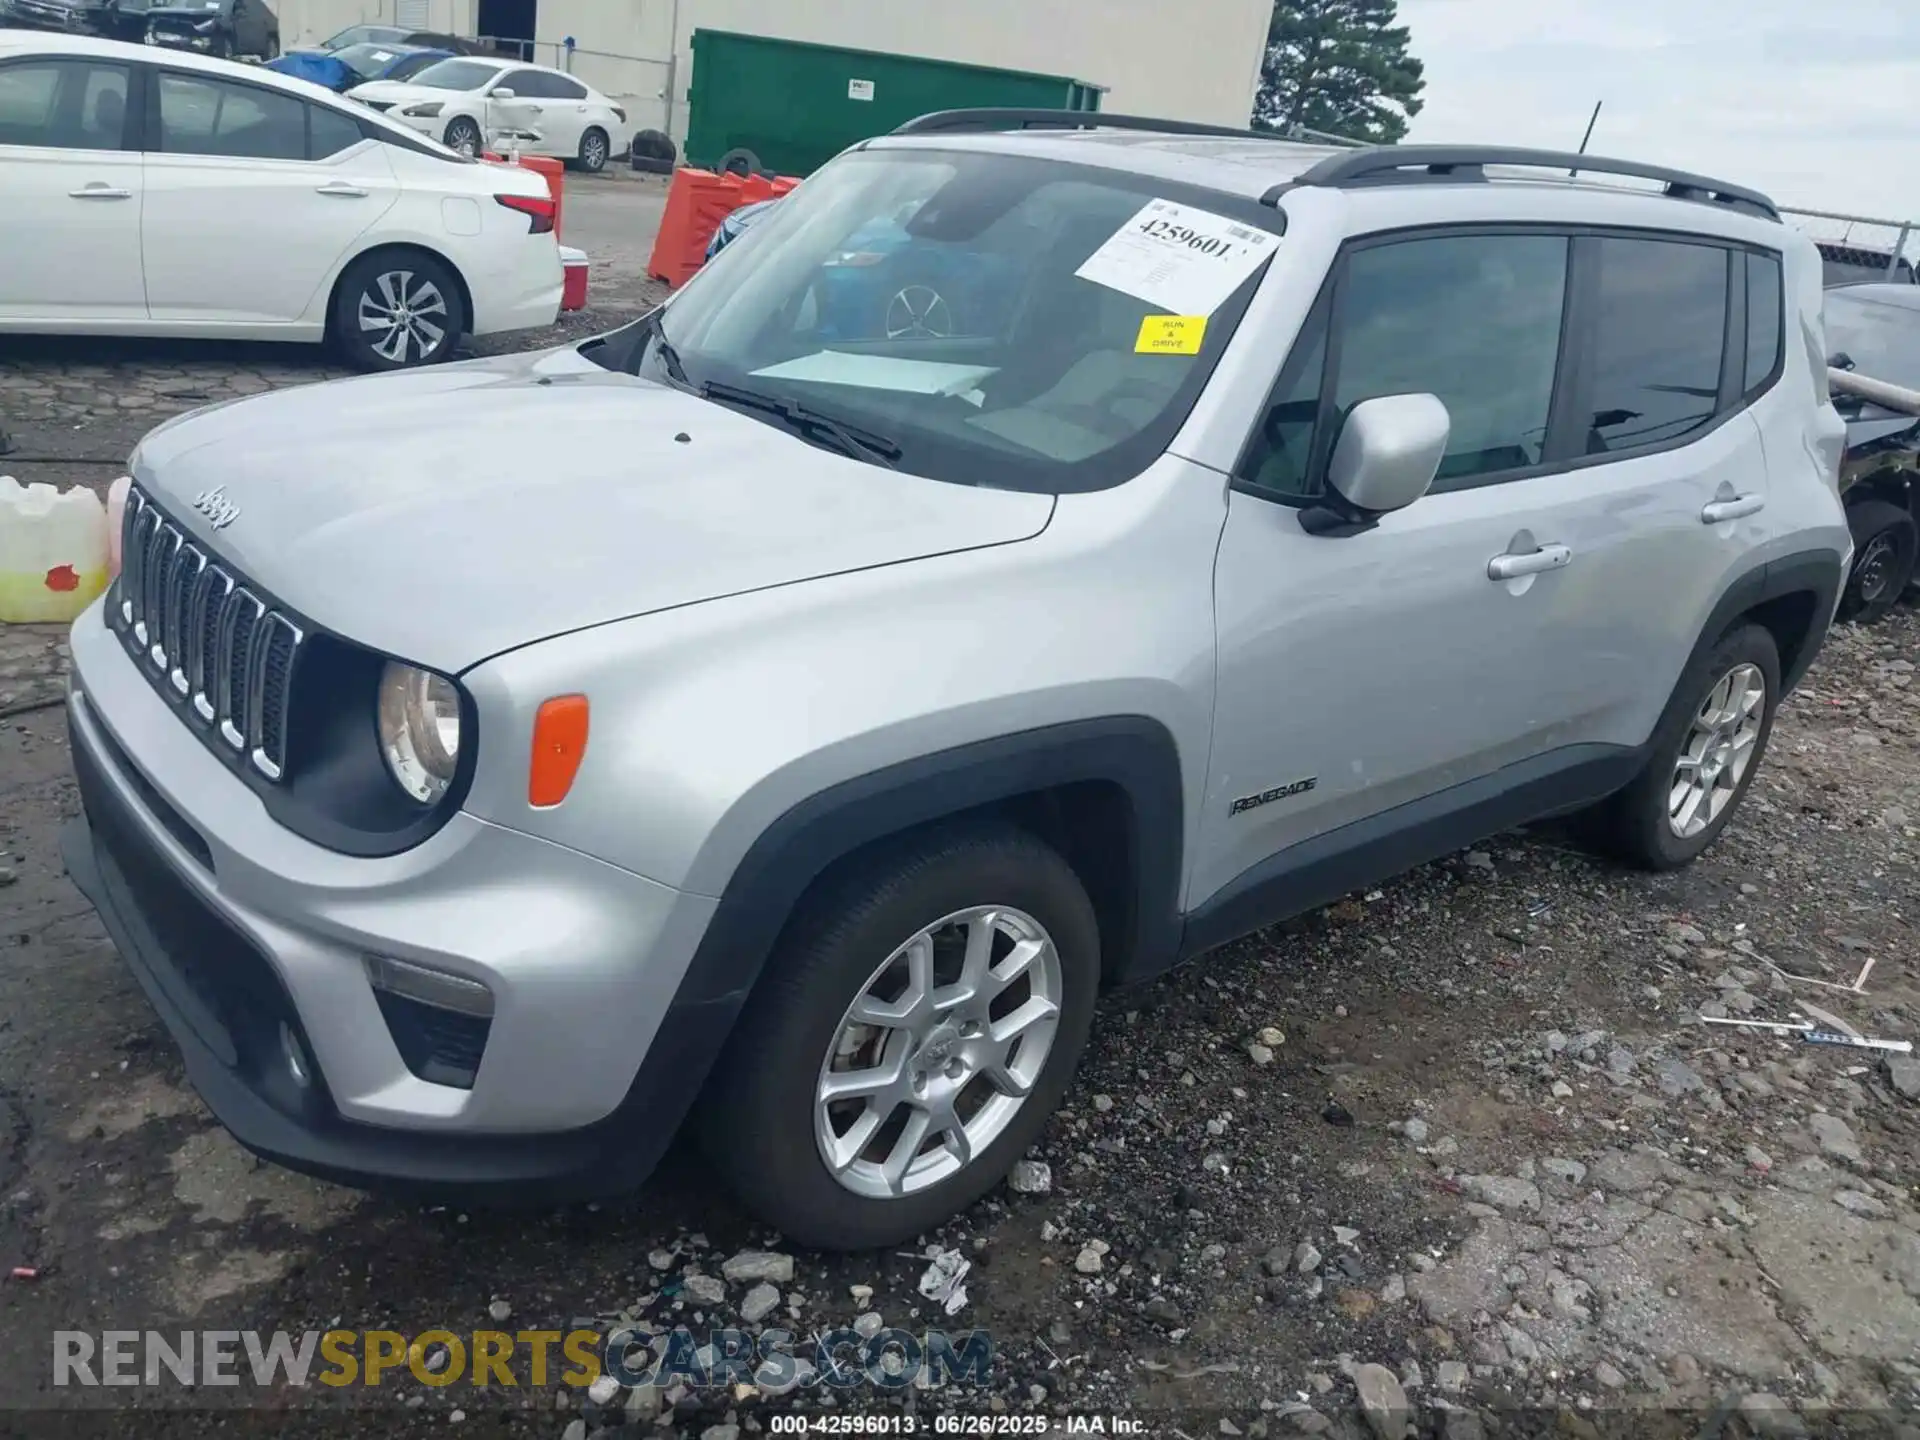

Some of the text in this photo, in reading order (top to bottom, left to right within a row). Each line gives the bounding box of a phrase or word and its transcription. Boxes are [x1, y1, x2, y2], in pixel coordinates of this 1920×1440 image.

[1162, 321, 1185, 329] RUN
[1151, 340, 1184, 349] DRIVE
[192, 484, 242, 532] Jeep
[1228, 775, 1319, 817] RENEGADE
